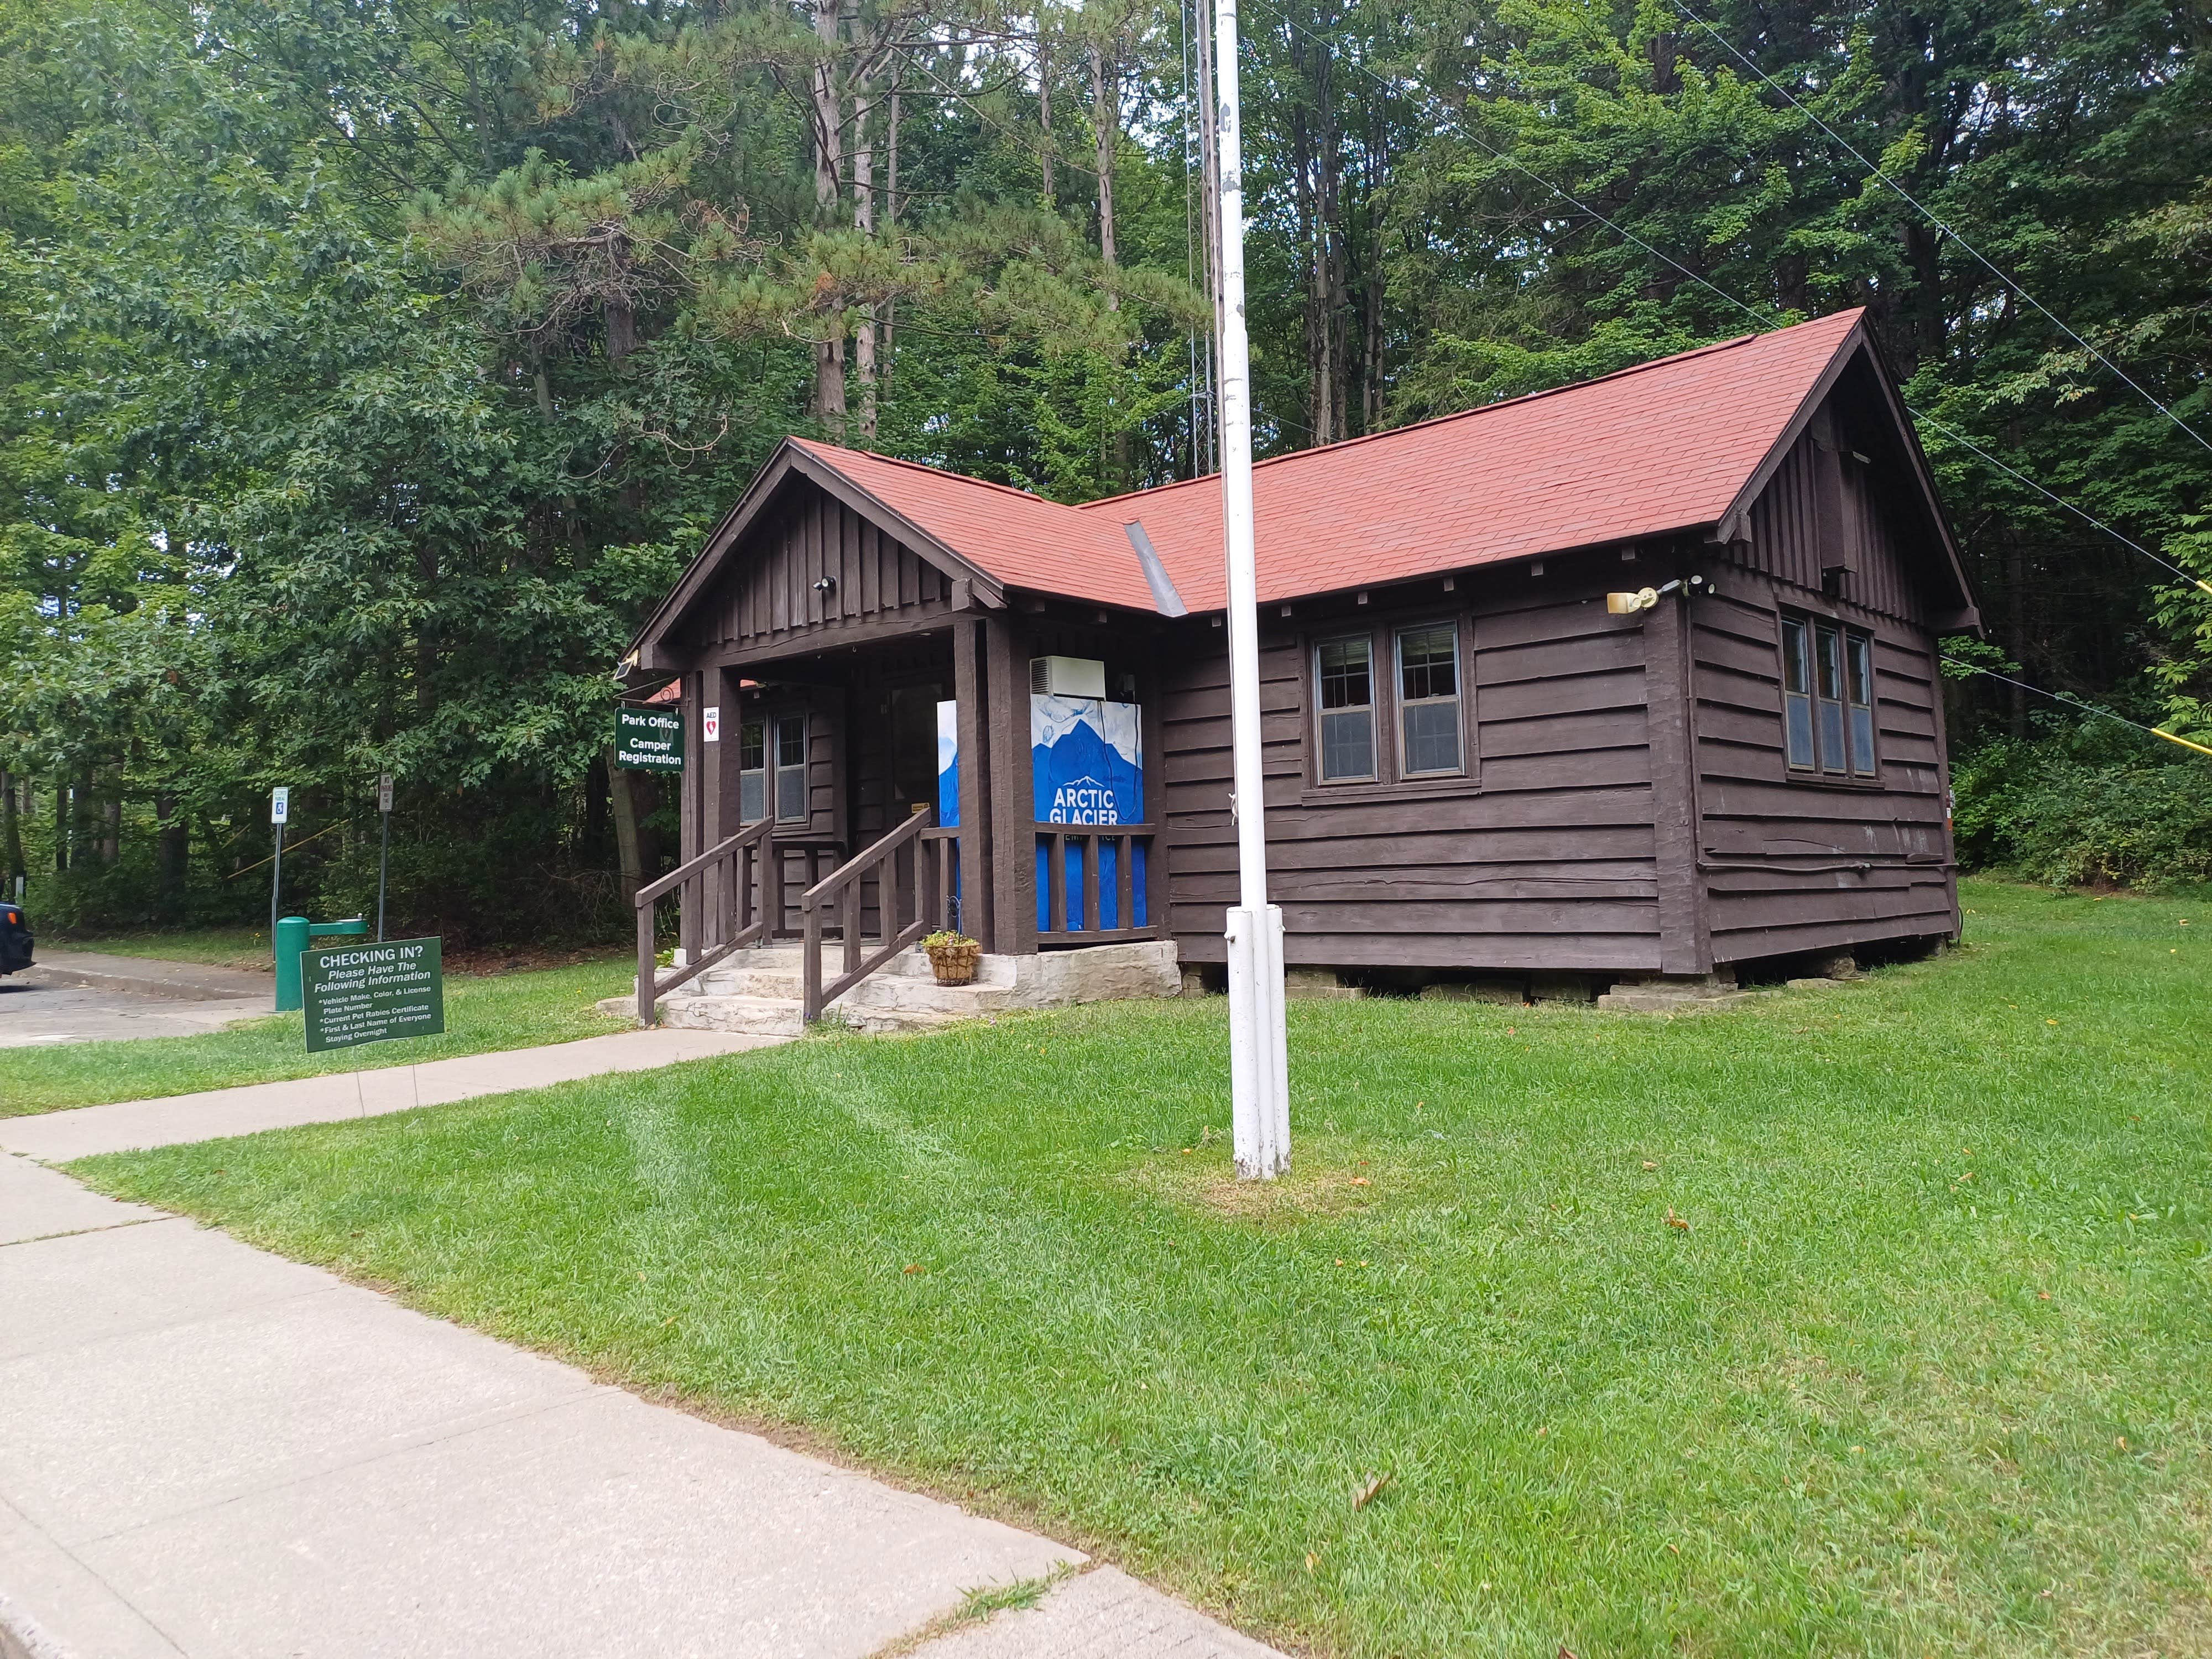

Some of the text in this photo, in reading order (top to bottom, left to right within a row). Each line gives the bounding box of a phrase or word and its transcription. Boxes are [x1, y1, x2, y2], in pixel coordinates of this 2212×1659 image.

[622, 714, 680, 729] Park Office
[630, 738, 671, 752] Camper
[619, 750, 681, 765] Registration
[1053, 788, 1114, 808] ARCTIC
[1050, 808, 1118, 826] GLACIER
[320, 945, 424, 968] CHECKING IN?
[328, 961, 416, 980] Please Have The
[314, 970, 431, 993] Following Information
[344, 1003, 373, 1012] Number
[366, 1010, 390, 1018] Rabies
[392, 1004, 429, 1014] Certificate
[350, 1021, 366, 1030] Last
[399, 1014, 431, 1022] Everyone
[326, 1027, 388, 1043] Staying Overnight
